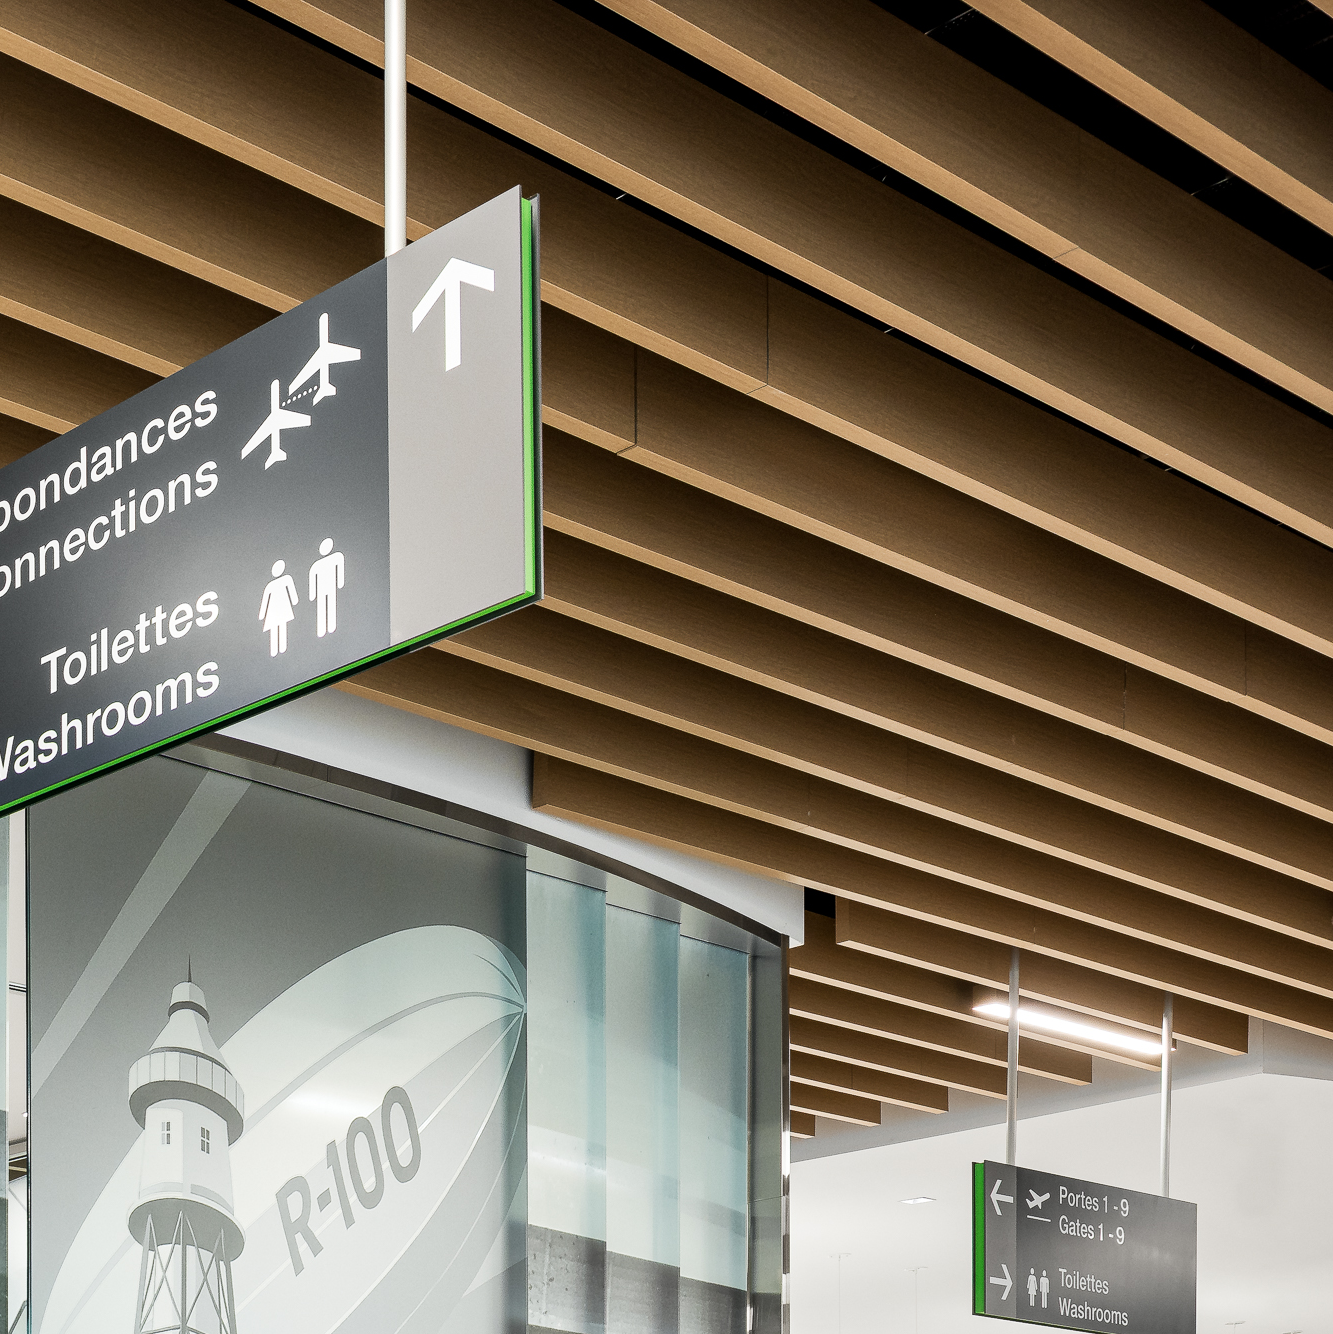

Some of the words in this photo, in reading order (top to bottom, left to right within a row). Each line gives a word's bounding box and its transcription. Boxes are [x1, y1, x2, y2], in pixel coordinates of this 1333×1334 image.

[40, 587, 220, 695] Toilettes
[275, 1086, 422, 1277] R-100
[1059, 1185, 1099, 1211] Portes
[1103, 1195, 1108, 1213] 1
[1120, 1198, 1129, 1217] 9
[1059, 1215, 1095, 1240] Gates
[1098, 1223, 1103, 1241] 1
[1116, 1226, 1125, 1245] 9
[1058, 1267, 1109, 1295] Toilettes
[1058, 1296, 1129, 1326] Washrooms
